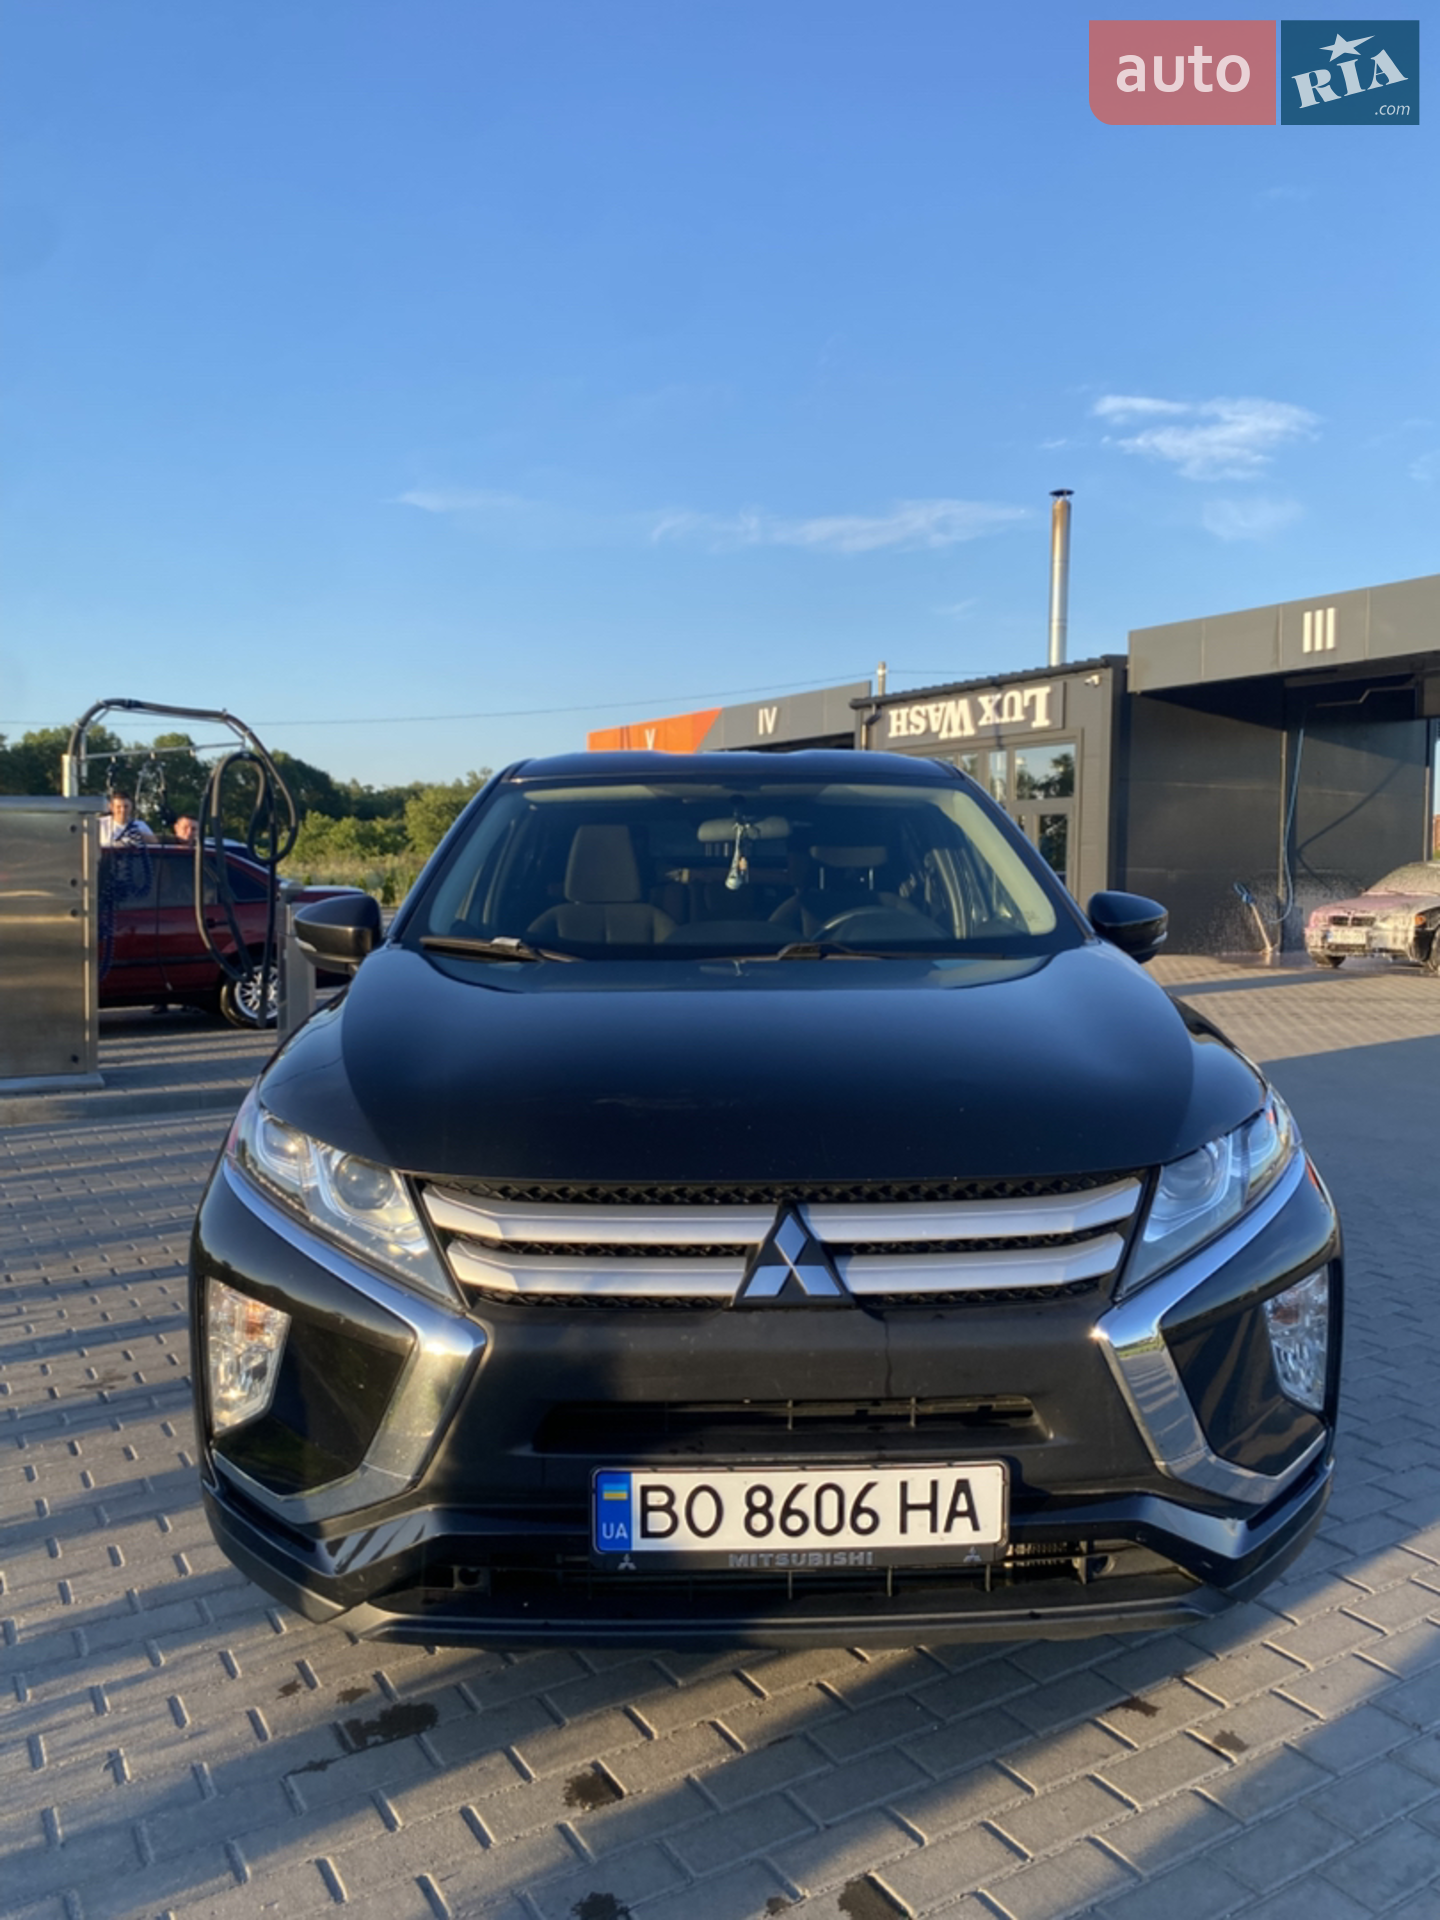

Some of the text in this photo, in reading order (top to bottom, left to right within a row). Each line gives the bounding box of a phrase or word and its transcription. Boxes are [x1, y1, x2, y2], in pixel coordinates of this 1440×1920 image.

[1303, 606, 1335, 653] III
[758, 706, 777, 736] IV
[639, 1478, 981, 1539] BO 8606 HA
[602, 1523, 628, 1540] UA
[728, 1551, 873, 1568] MITSUBISHI
